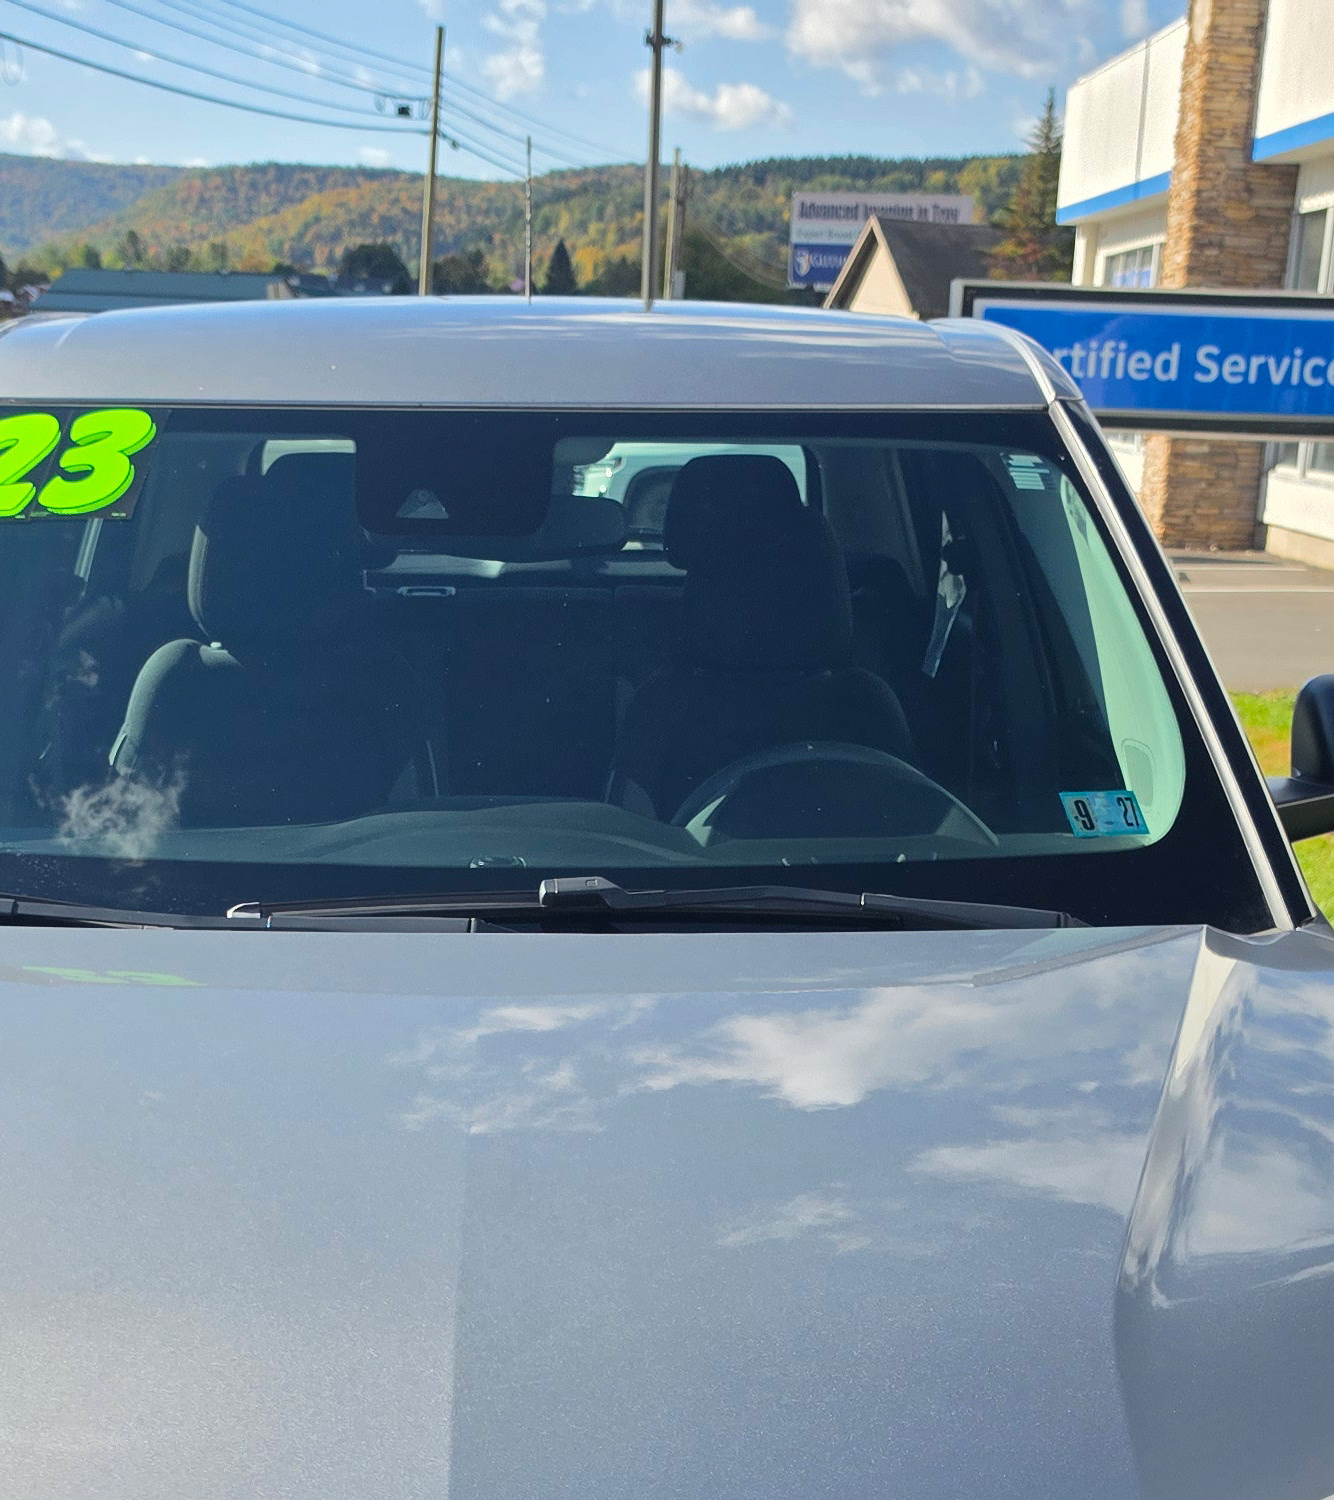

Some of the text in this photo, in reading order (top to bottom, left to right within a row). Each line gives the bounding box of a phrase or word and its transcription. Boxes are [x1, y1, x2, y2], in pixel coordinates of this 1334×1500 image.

[1053, 340, 1181, 382] rtified
[1073, 796, 1140, 831] 9 27
